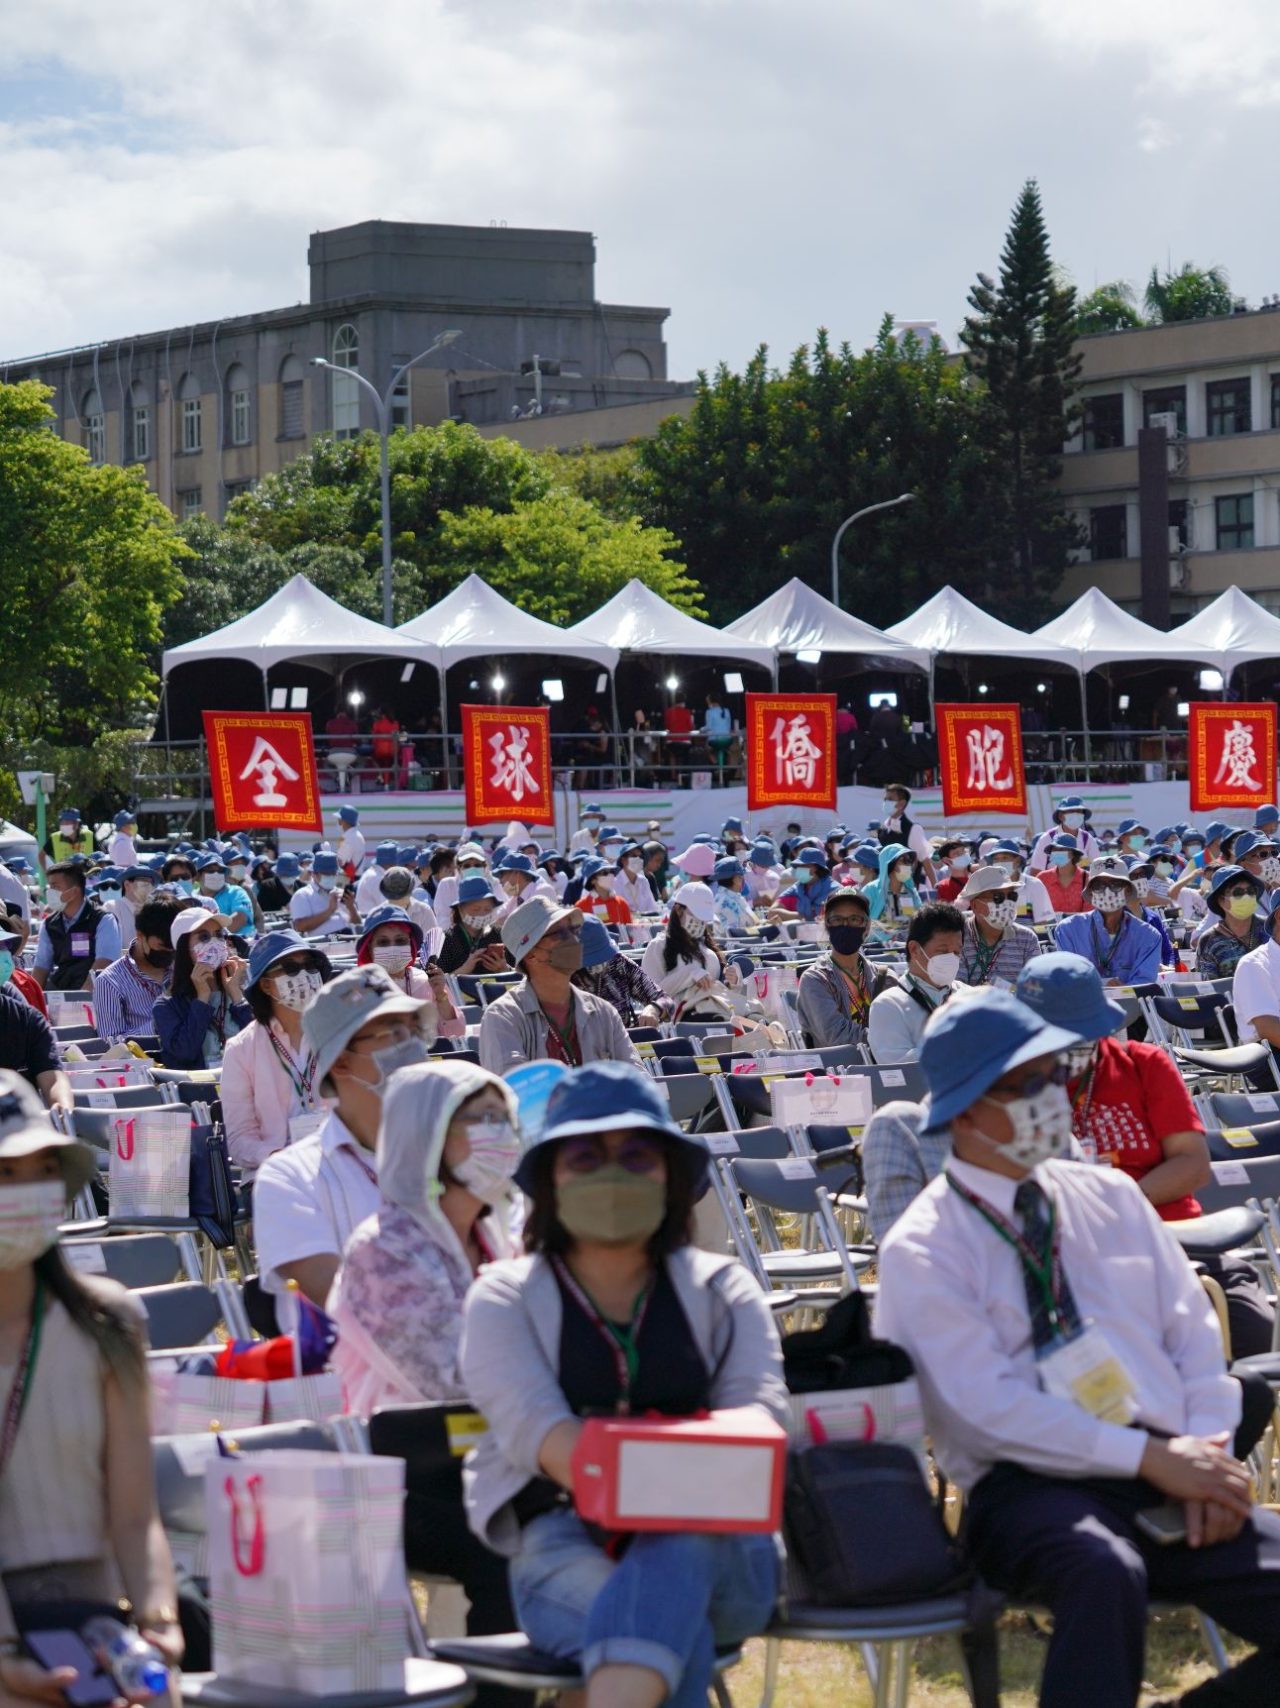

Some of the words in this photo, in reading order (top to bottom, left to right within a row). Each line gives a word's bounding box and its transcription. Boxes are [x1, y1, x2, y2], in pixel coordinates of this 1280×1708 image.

[238, 735, 301, 809] 全
[488, 725, 541, 802] 球
[769, 713, 822, 789] 僑
[965, 725, 1015, 791] 胞
[1213, 720, 1263, 791] 慶
